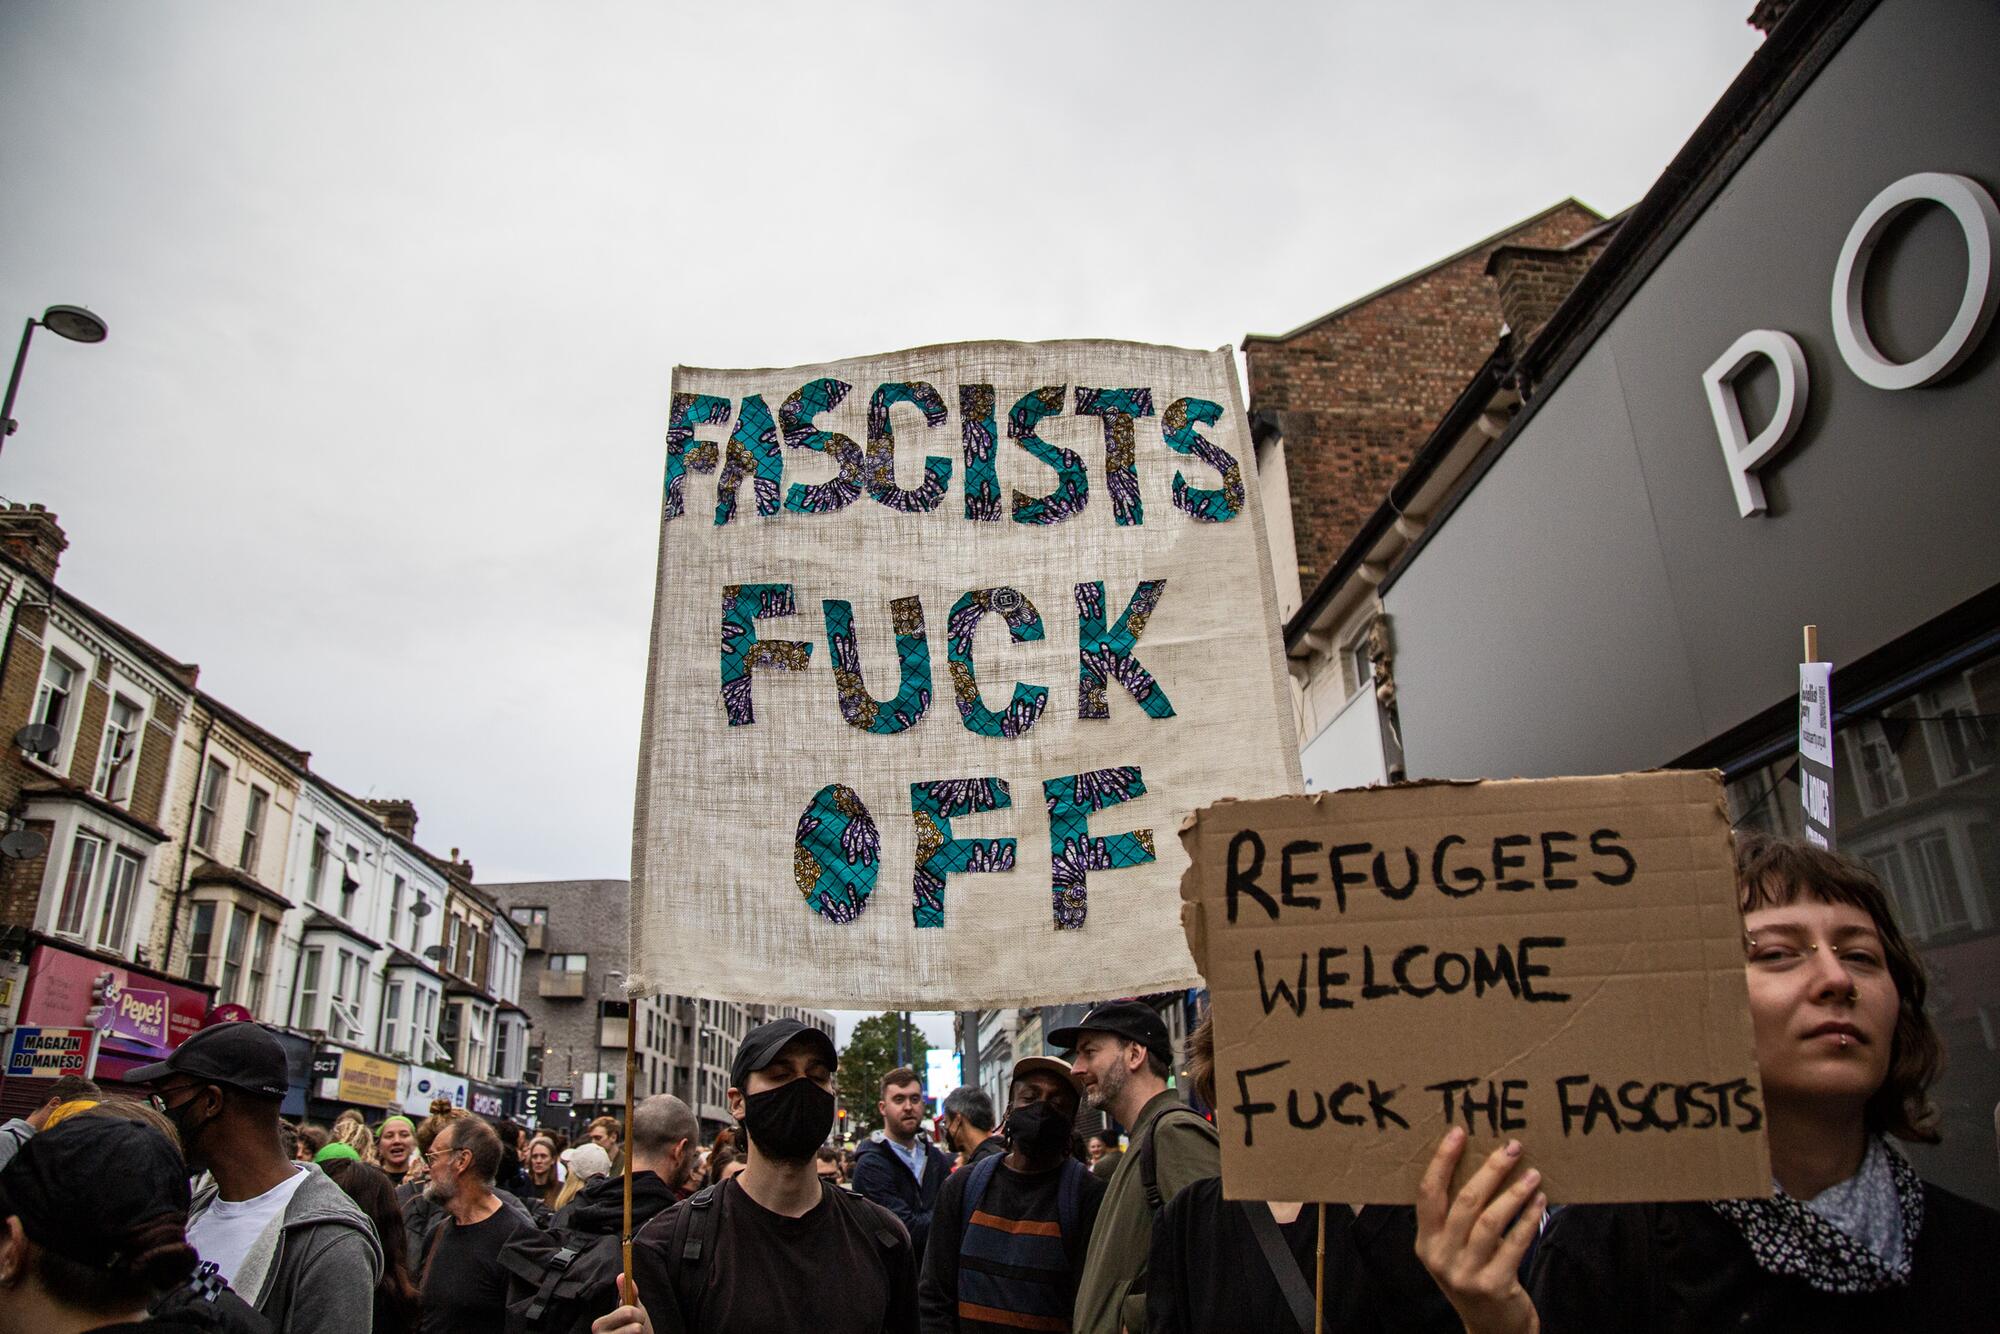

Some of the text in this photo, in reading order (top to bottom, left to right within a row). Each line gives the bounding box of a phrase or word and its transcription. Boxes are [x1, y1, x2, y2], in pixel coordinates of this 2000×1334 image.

[1702, 172, 2000, 518] PO
[665, 378, 1245, 526] FASCISTS
[721, 579, 1177, 739] FUCK
[794, 766, 1156, 931] OFF
[1225, 829, 1638, 924] REFUGEES
[120, 993, 163, 1027] Pepe's
[1253, 937, 1572, 1017] WELCOME
[13, 1053, 84, 1069] ROMANESC
[23, 1035, 81, 1050] MAGAZIN
[1234, 1060, 1763, 1146] FUCK THE FASCISTS
